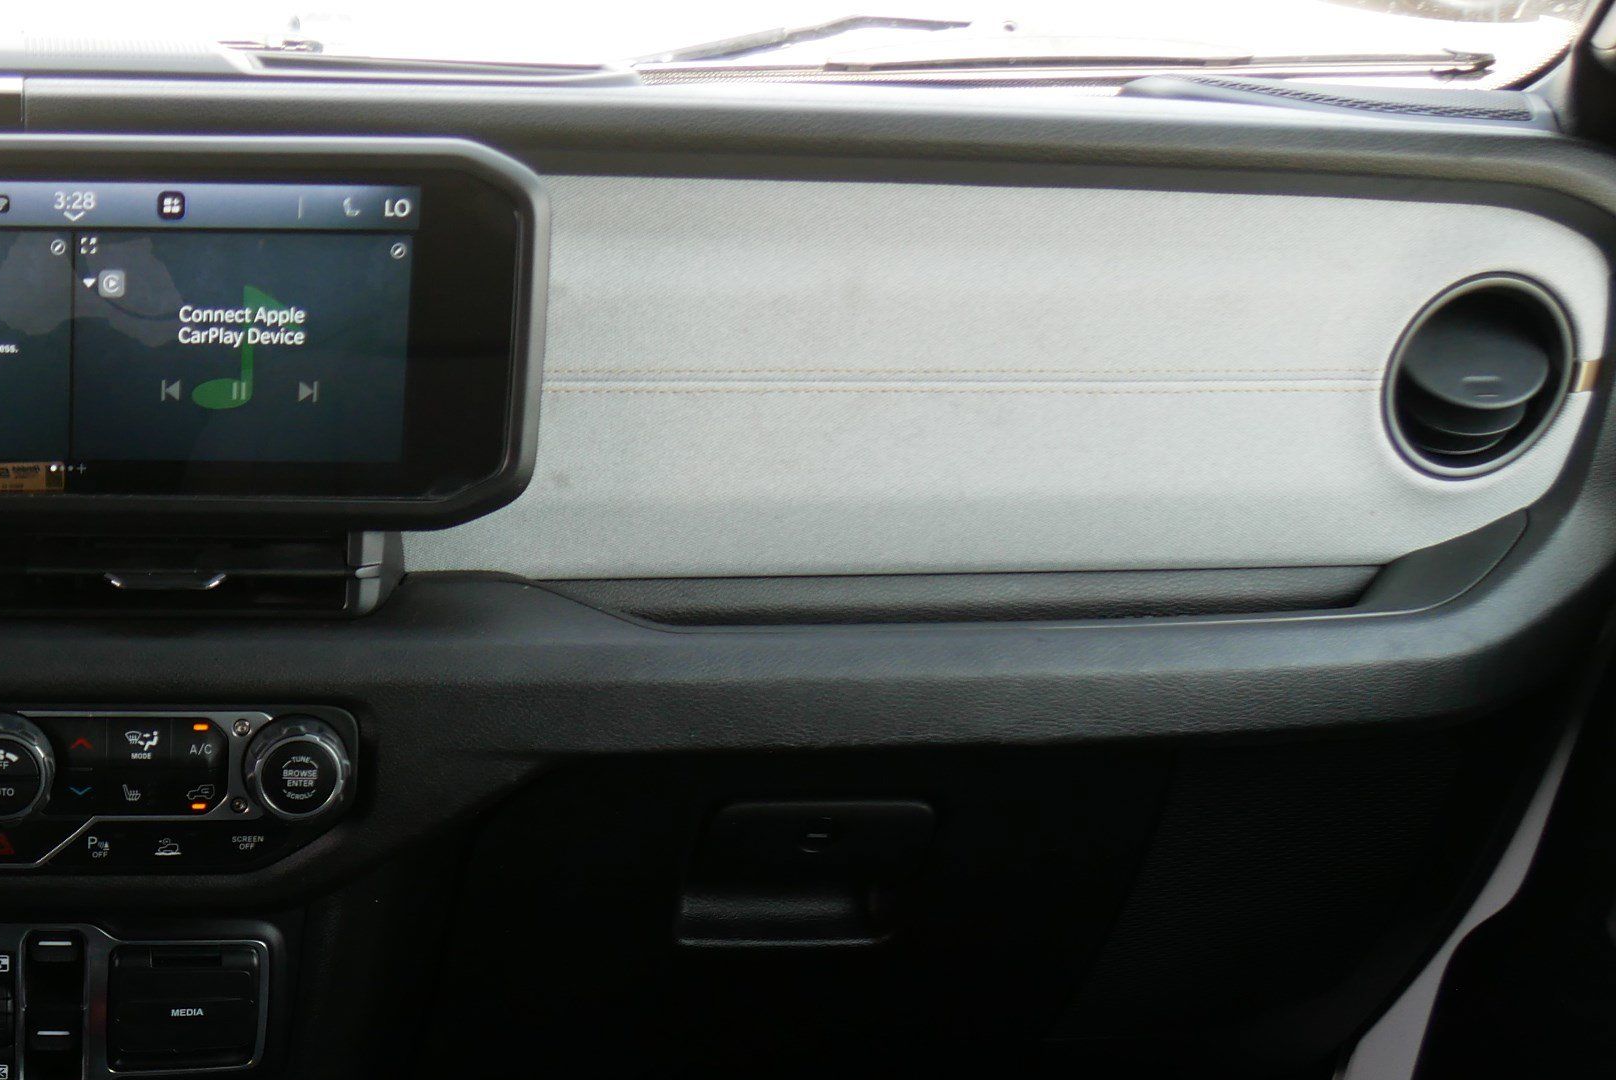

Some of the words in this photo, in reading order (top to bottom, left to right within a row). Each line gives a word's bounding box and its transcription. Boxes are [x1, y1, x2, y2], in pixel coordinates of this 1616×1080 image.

[53, 192, 96, 211] 3:28
[383, 198, 411, 218] LO
[178, 306, 252, 324] Connect
[254, 306, 305, 328] Apple
[178, 327, 245, 348] CarPlay
[247, 328, 305, 345] Device
[189, 744, 213, 756] A/C
[131, 752, 152, 760] MODE
[291, 755, 311, 764] TUNE
[282, 769, 318, 778] BROWSE
[286, 778, 314, 788] ENTER
[285, 789, 314, 800] SCROLL
[232, 835, 264, 844] SCREEN
[92, 851, 108, 859] OFF
[171, 1008, 204, 1017] MEDIA
